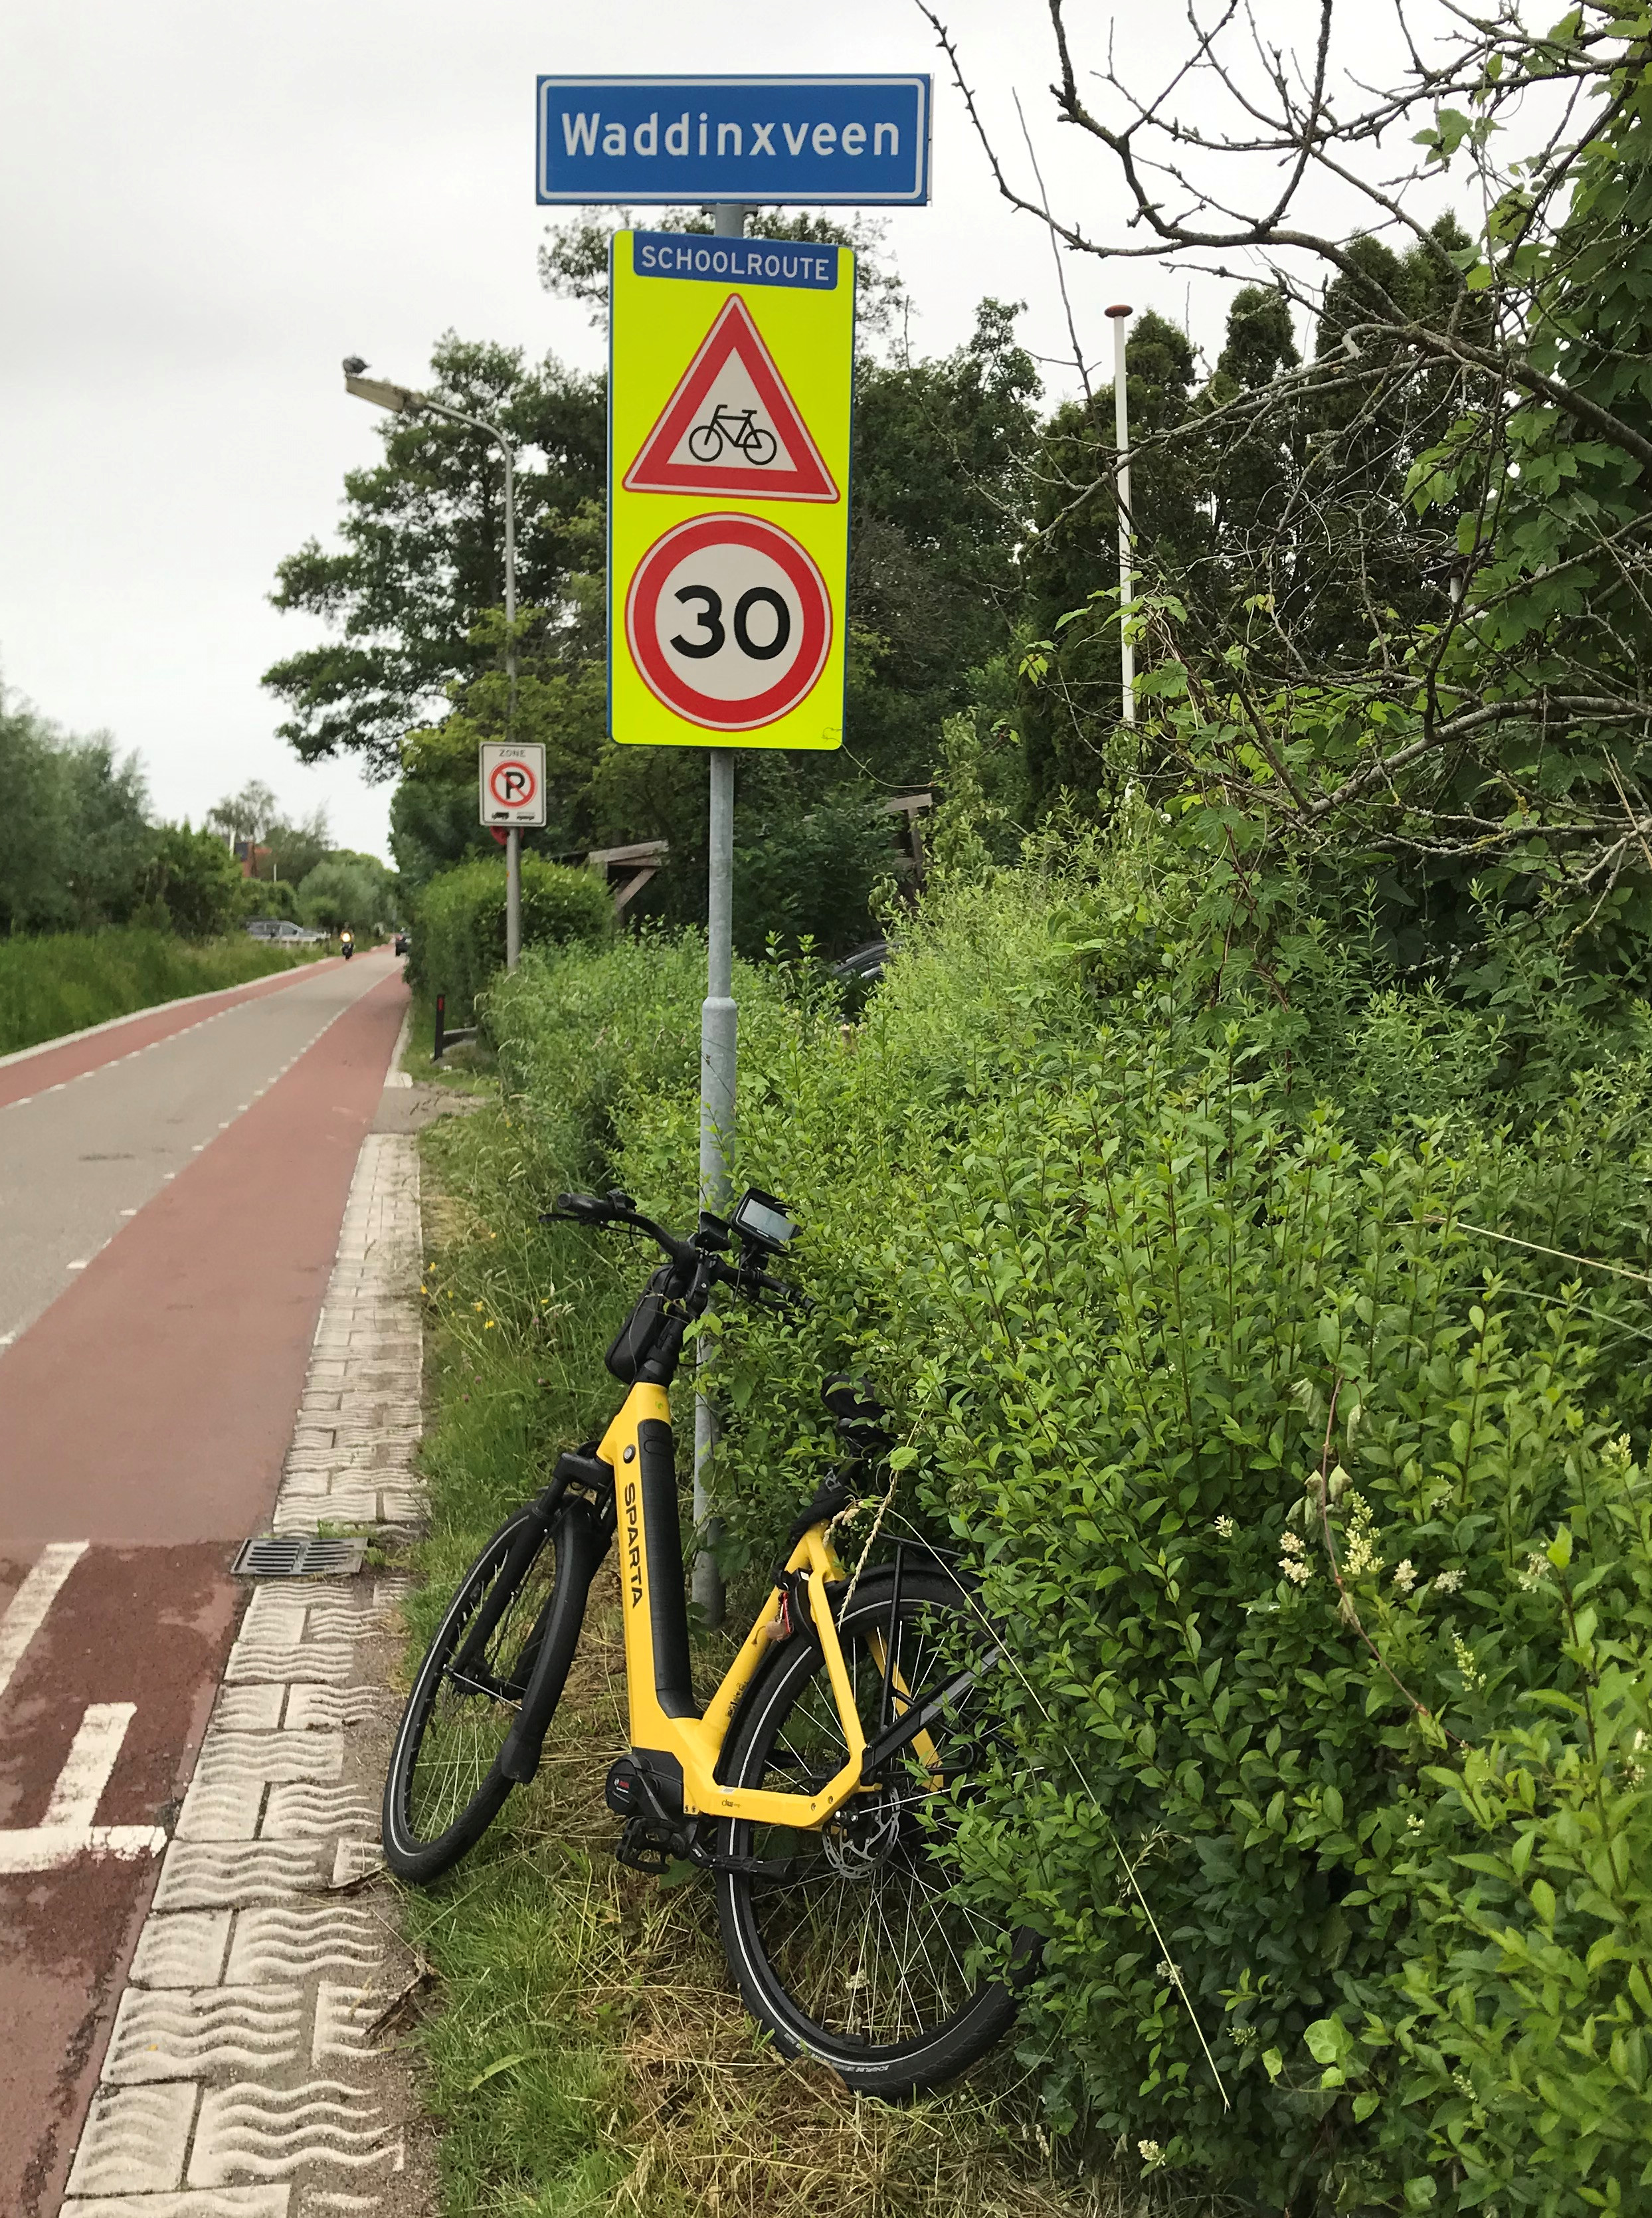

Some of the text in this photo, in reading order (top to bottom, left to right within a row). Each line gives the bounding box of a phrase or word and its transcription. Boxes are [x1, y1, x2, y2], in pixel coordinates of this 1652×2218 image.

[561, 112, 899, 156] Waddinxveen
[641, 244, 830, 282] SCHOOLROUTE
[670, 585, 791, 660] 30
[499, 749, 527, 757] ZONE
[624, 1481, 643, 1609] SPARTA
